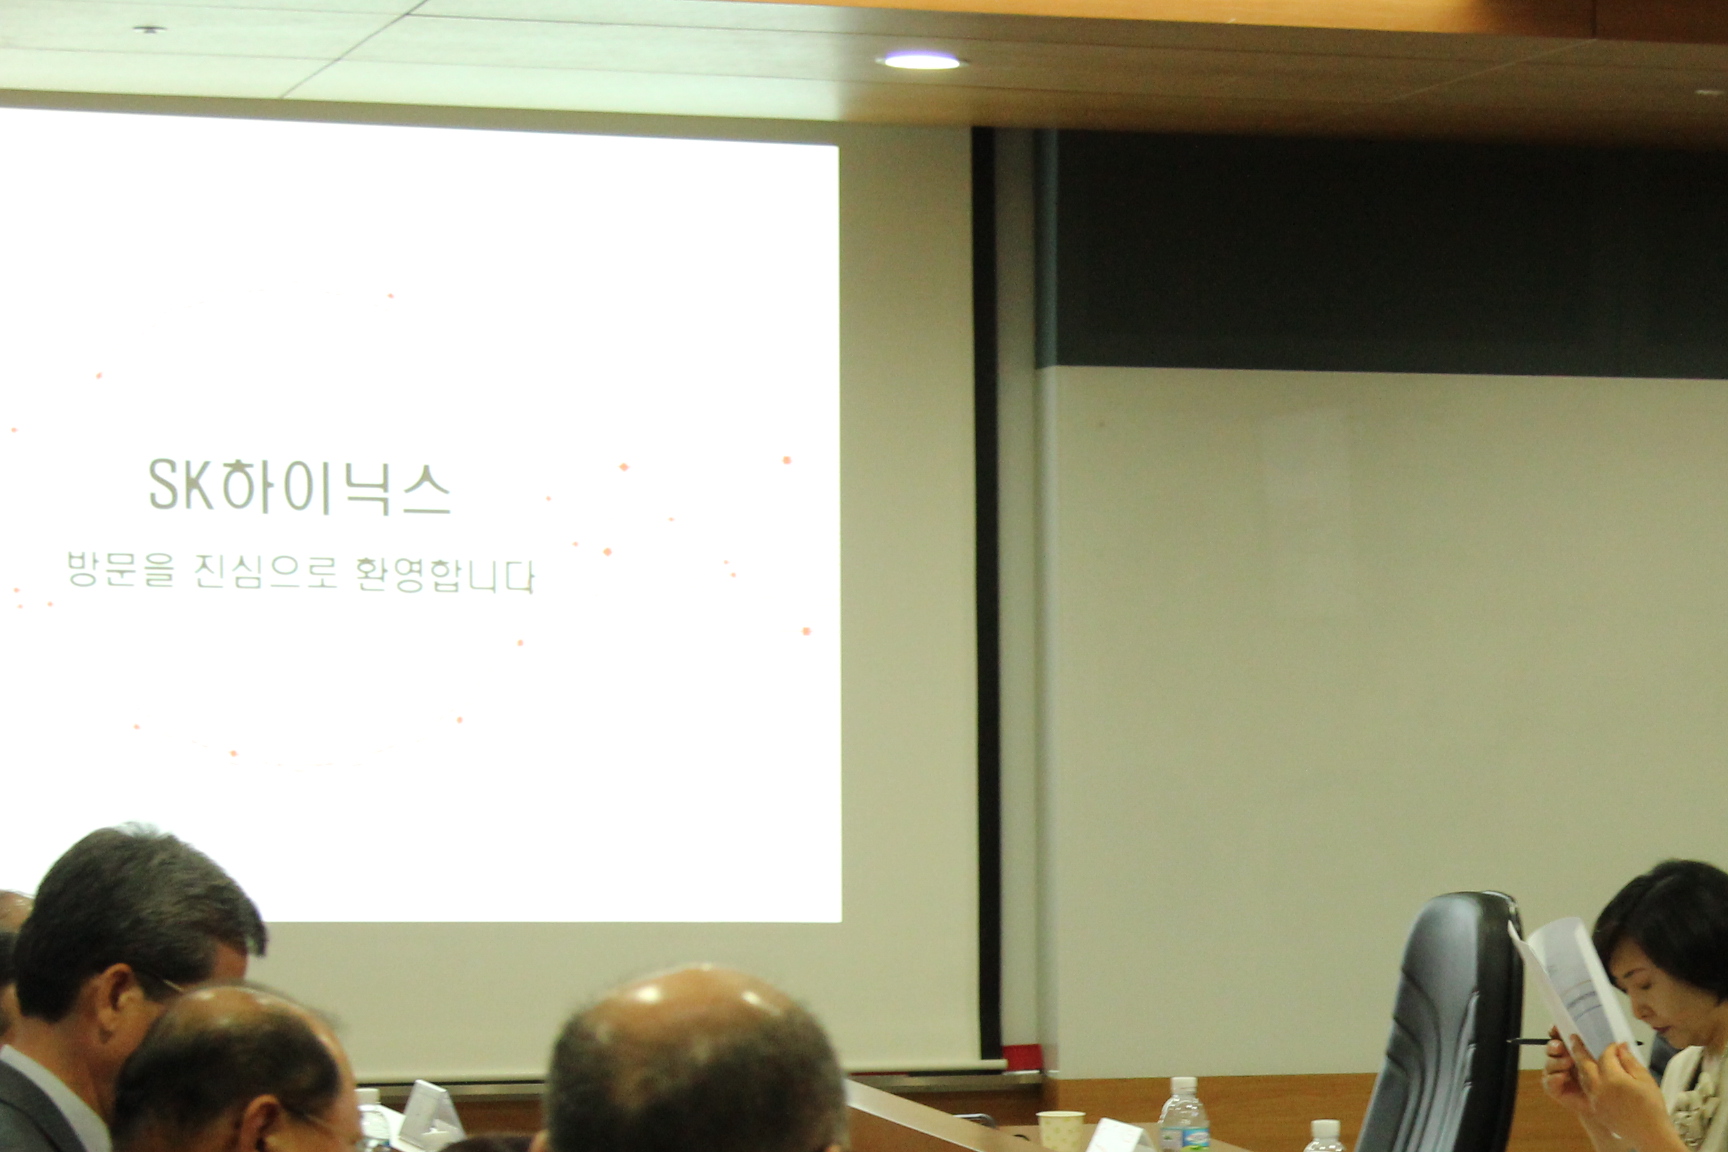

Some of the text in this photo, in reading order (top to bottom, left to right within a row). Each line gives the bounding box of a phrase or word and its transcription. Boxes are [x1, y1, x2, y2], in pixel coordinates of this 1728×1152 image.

[148, 457, 452, 517] SK하이닉스
[67, 551, 537, 595] 방문을 진심으로 환영합니다
